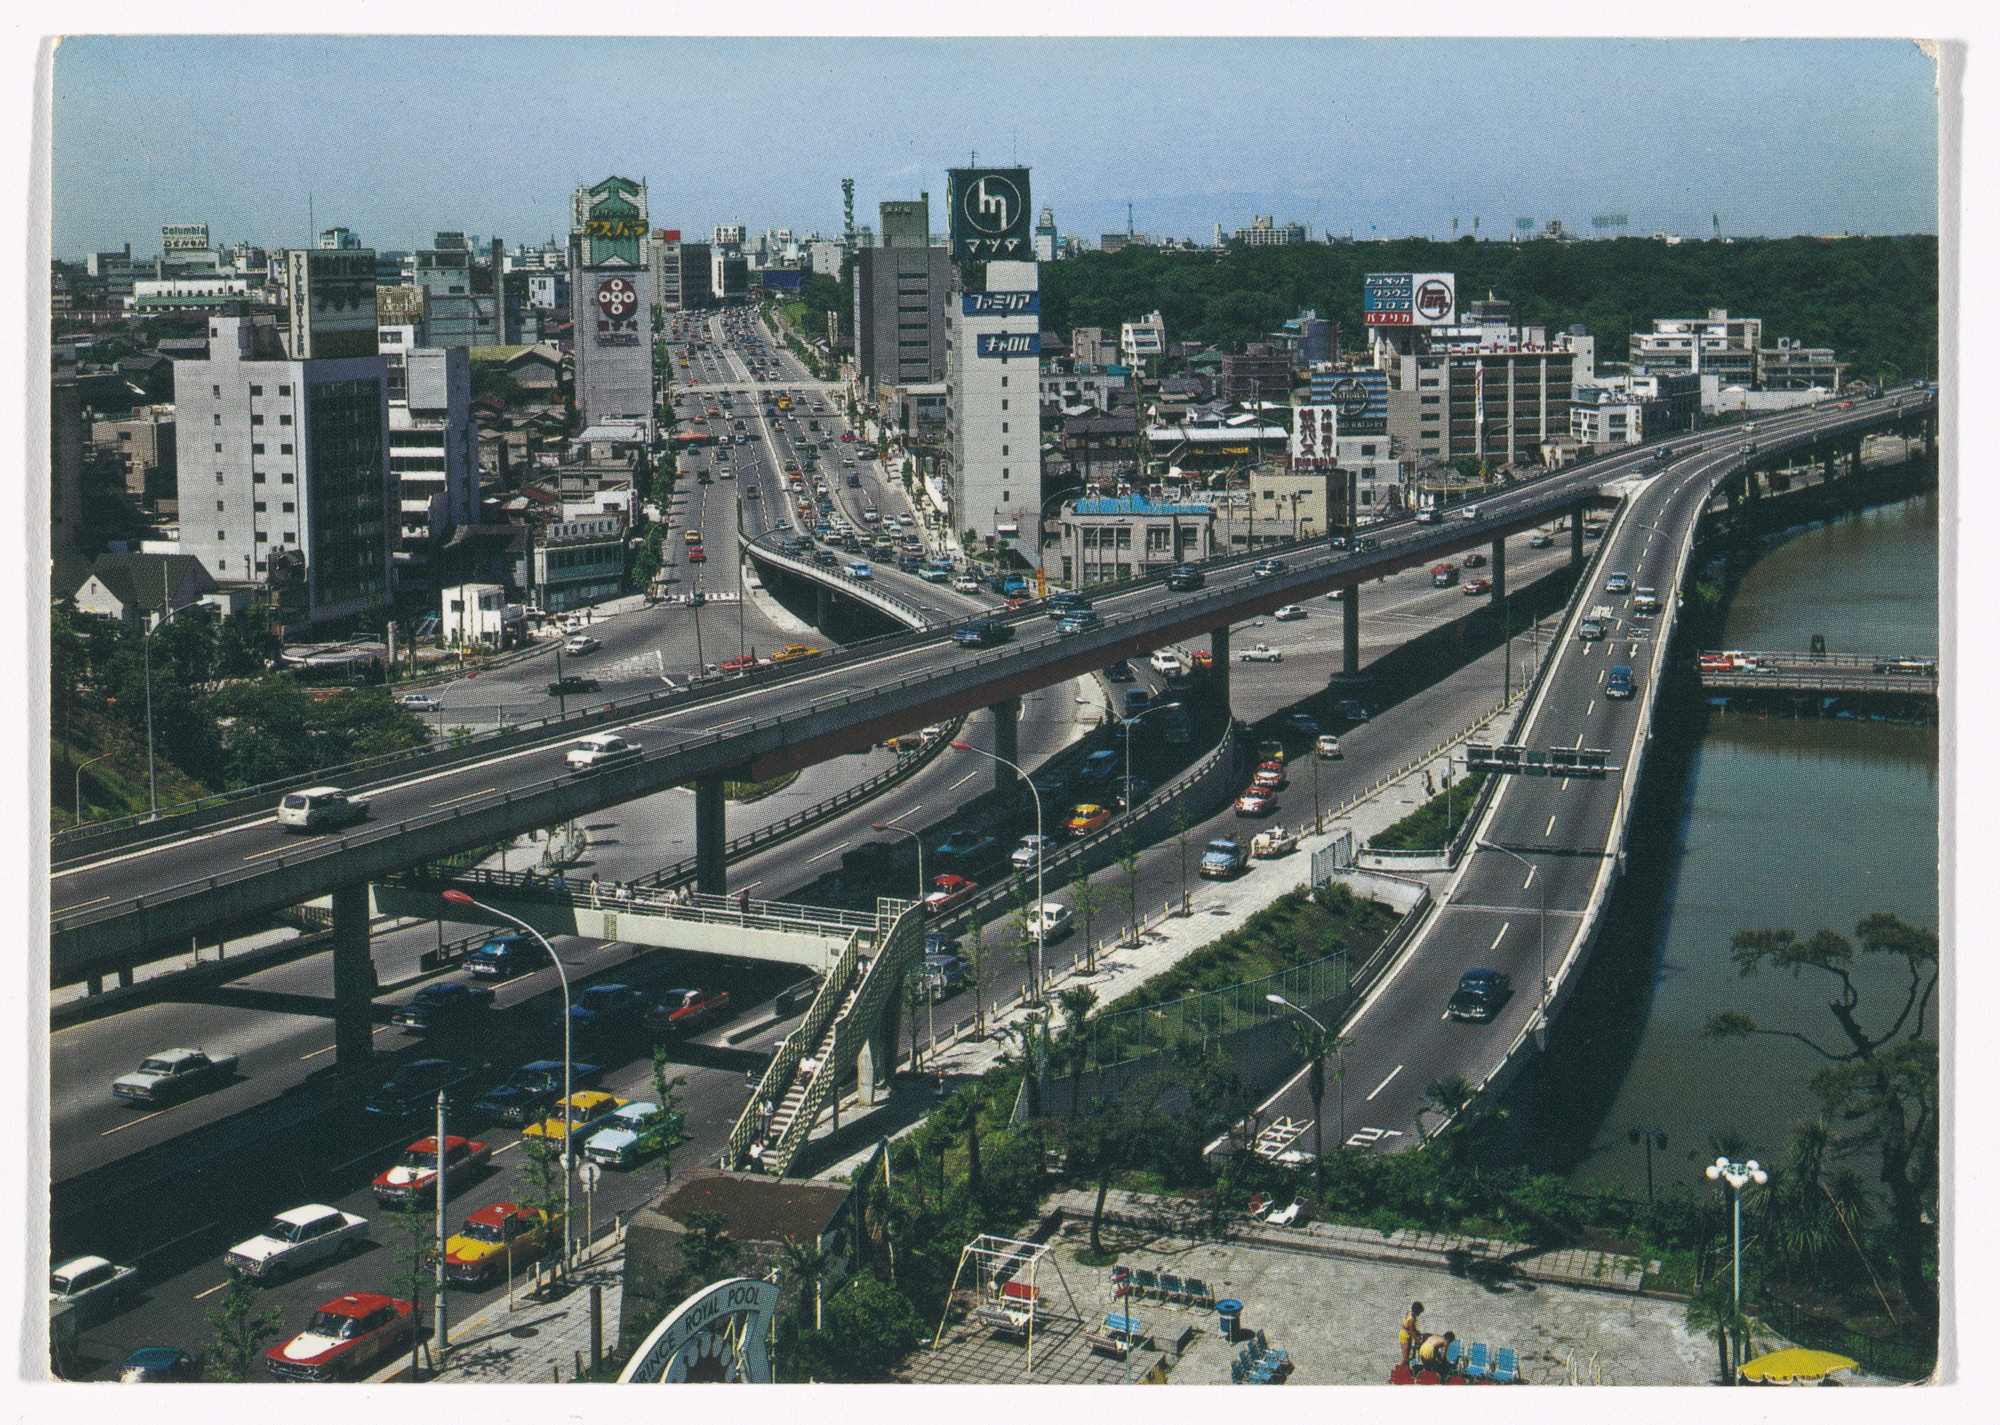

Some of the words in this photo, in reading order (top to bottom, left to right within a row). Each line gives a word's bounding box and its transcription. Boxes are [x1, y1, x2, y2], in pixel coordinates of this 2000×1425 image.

[162, 225, 206, 235] Columbia
[585, 220, 647, 237] アスパラ
[163, 239, 205, 248] DENON
[965, 238, 1021, 253] マツダ
[1373, 288, 1411, 298] クラウン
[294, 253, 305, 357] TYPEWRITER
[970, 293, 1031, 310] ファミリア
[1372, 301, 1411, 310] コロナ
[1366, 312, 1410, 323] パブリカ
[985, 336, 1031, 352] キャロル
[553, 520, 613, 537] BROTHER
[634, 1331, 676, 1384] RINCE
[685, 1296, 719, 1333] ROYAL
[728, 1286, 760, 1306] POOL
